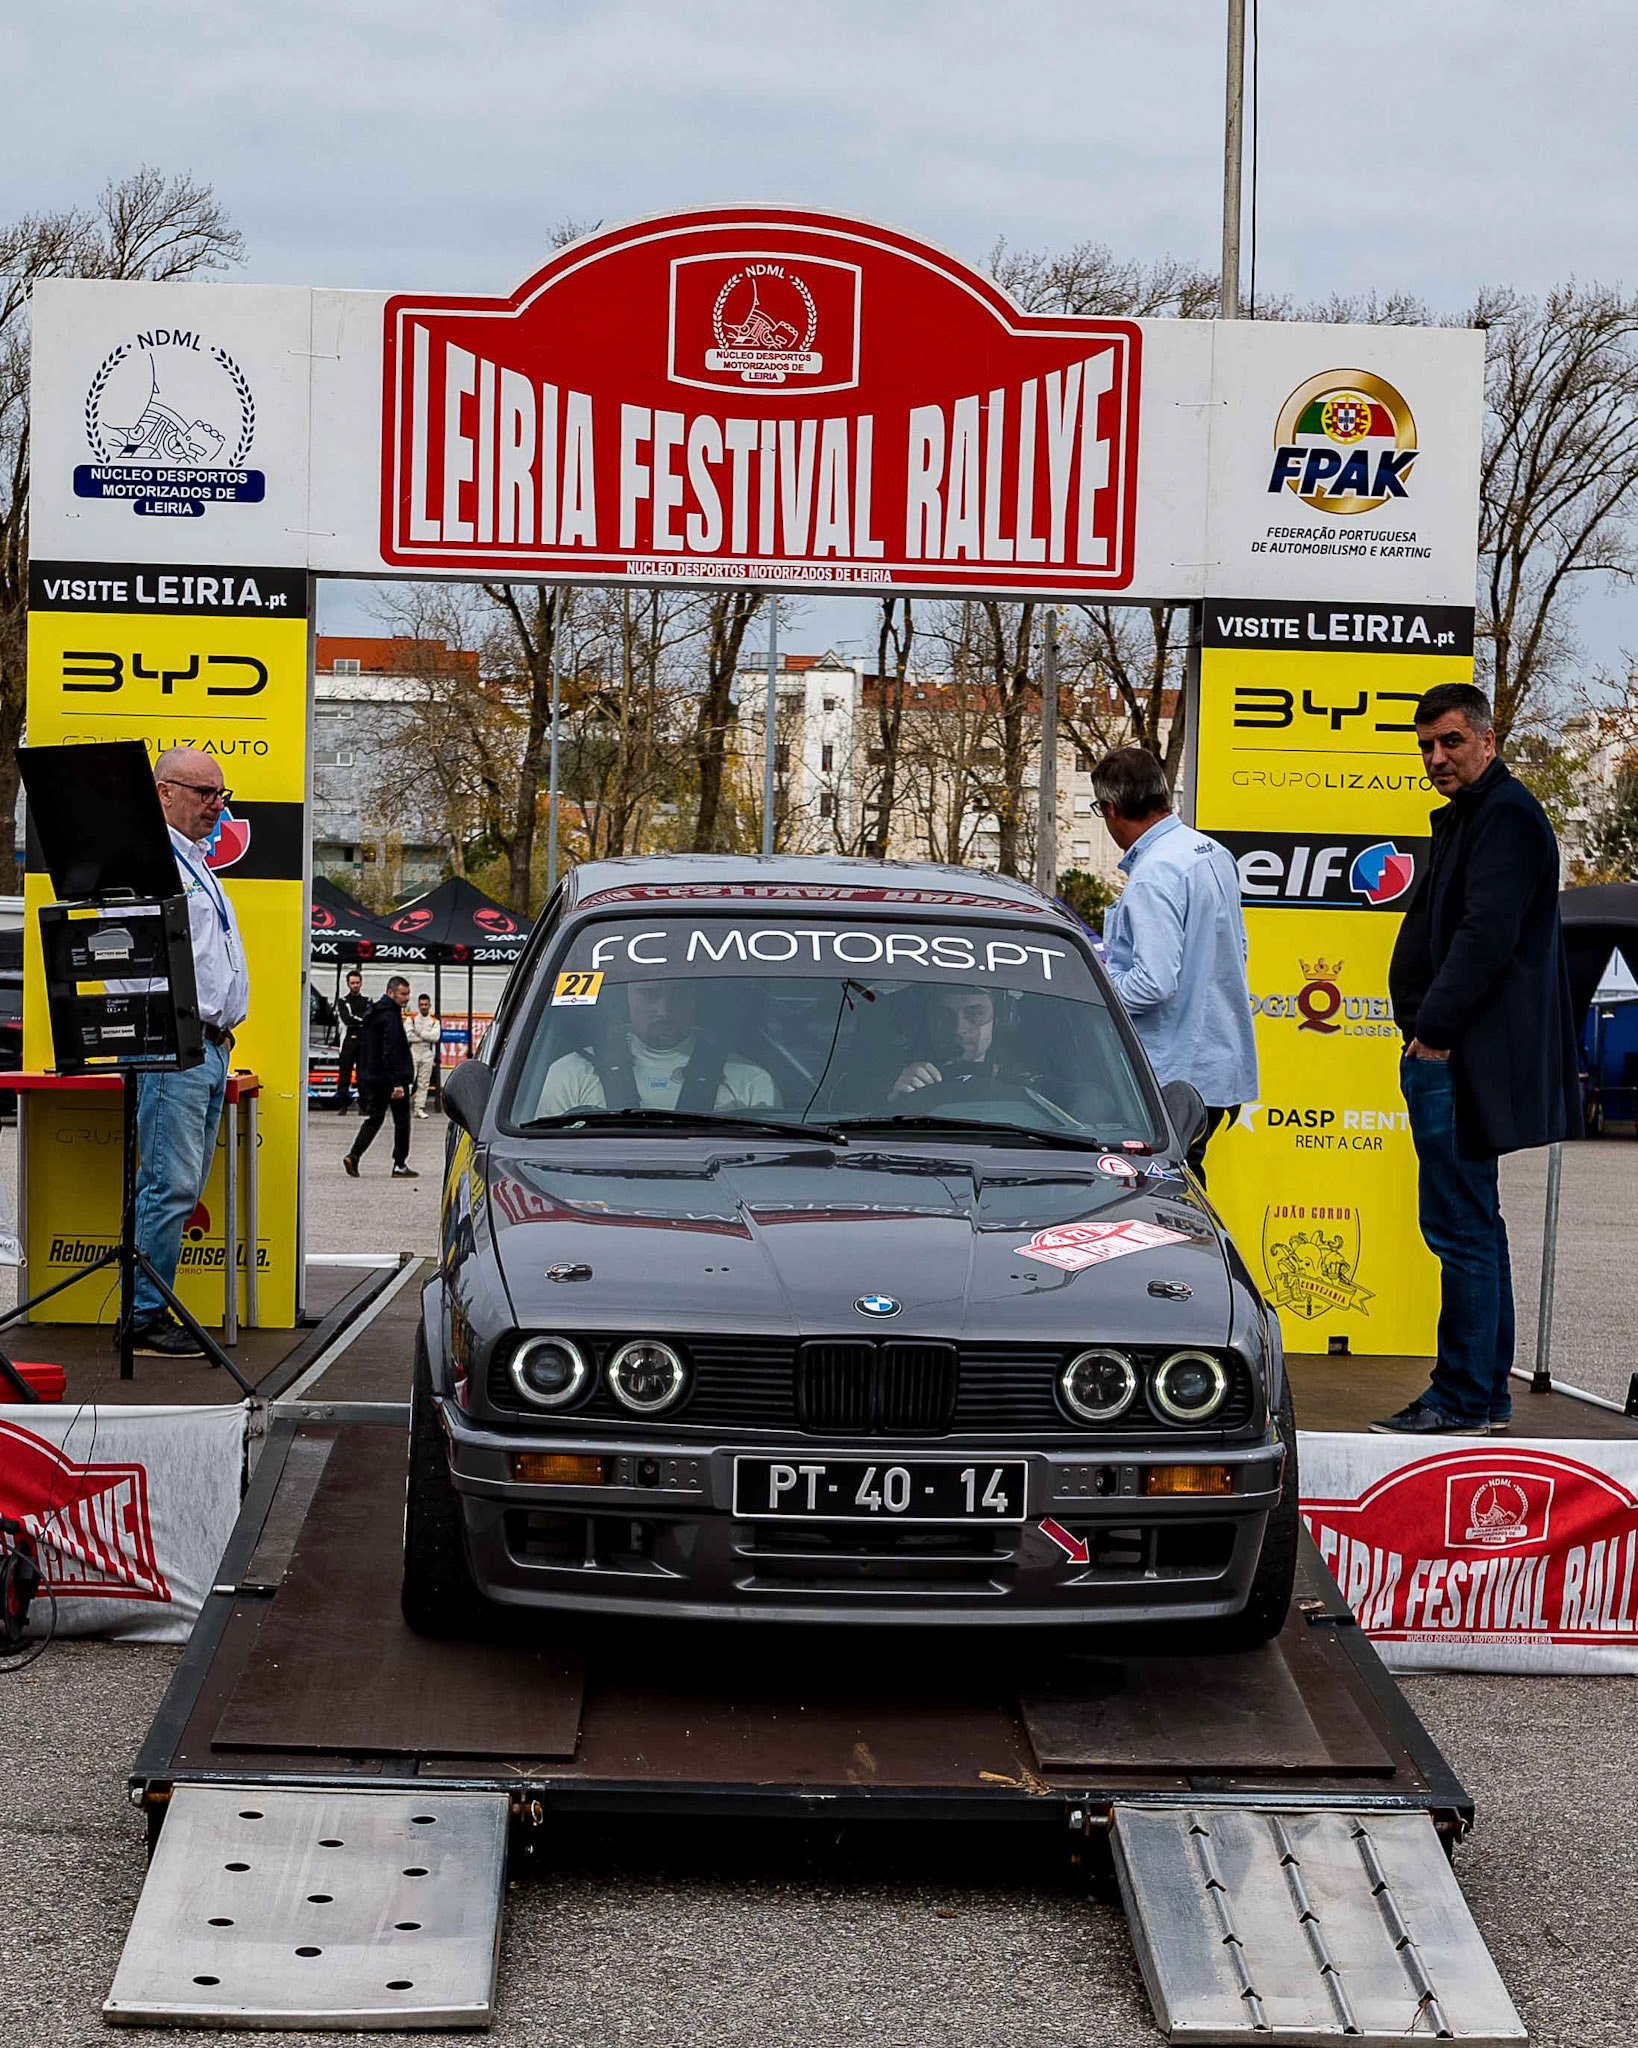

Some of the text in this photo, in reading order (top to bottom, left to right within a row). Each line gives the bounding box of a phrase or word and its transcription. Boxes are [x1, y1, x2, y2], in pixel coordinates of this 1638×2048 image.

[745, 264, 785, 279] NDML
[137, 328, 201, 352] NDML
[723, 361, 805, 371] MOTORIZADOS DE
[756, 352, 812, 362] DESPORTOS
[748, 372, 778, 381] LEIRIA
[409, 321, 1115, 567] LEIRIA FESTIVAL RALLYE
[156, 470, 248, 485] DESPORTOS
[1267, 446, 1421, 498] FPAK
[102, 484, 236, 500] MOTORIZADOS DE
[145, 501, 194, 515] LEIRIA
[1267, 526, 1417, 543] FEDERAÇÃO PORTUGUESA
[1251, 541, 1432, 559] DE AUTOMOBILISMO E KARTING
[626, 561, 892, 583] NUCLEO DESPORTOS MOTORIZADOS DE LEIRIA
[43, 578, 129, 602] VISITE
[1216, 616, 1300, 639] VISITE
[62, 650, 268, 697] BYD
[1232, 770, 1434, 792] GRUPOLIZAUTO
[1238, 845, 1348, 898] elf
[591, 929, 1066, 981] FC MOTORS.PT
[561, 974, 595, 996] 27
[1267, 1106, 1409, 1131] DASP RENT
[1295, 1134, 1383, 1151] RENT A CAR
[1311, 1207, 1351, 1220] GORDO
[1488, 1478, 1512, 1488] NDML
[1403, 1554, 1551, 1630] FESTIVAL
[1406, 1634, 1553, 1645] NUCLEO DESPORTOS MOTORIZADOS DE LEIRIA
